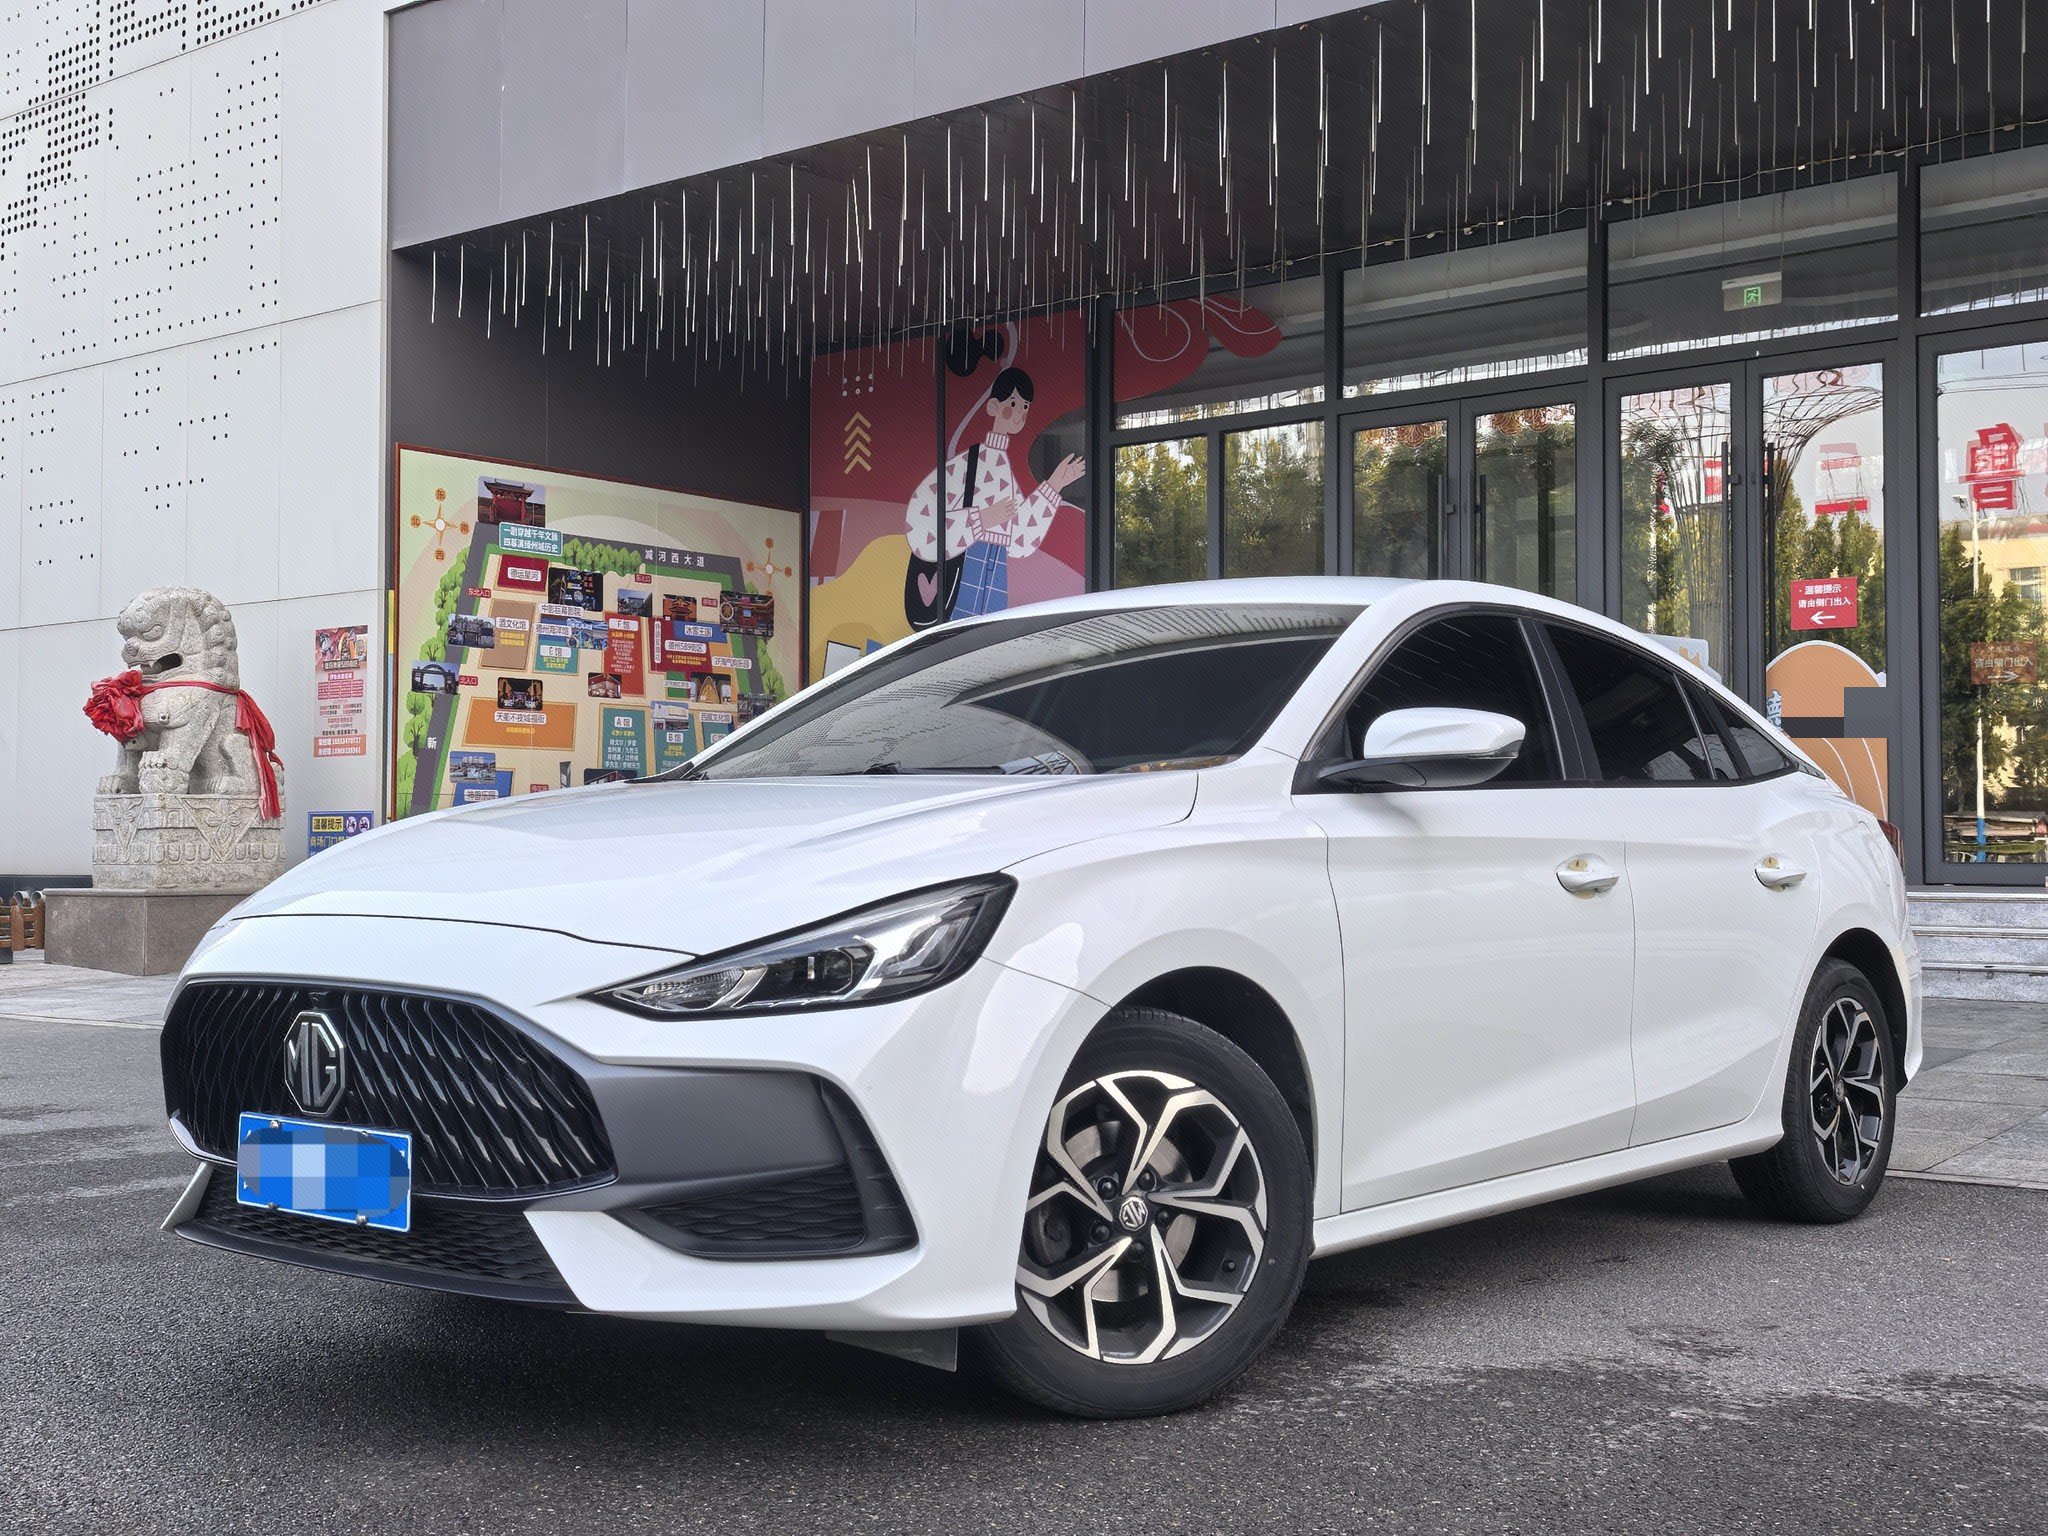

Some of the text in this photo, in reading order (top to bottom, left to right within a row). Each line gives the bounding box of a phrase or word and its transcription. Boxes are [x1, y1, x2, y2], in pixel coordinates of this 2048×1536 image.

[1805, 584, 1841, 595] 温馨提示
[1798, 596, 1851, 608] 请由侧门出入
[427, 737, 437, 750] 新
[313, 818, 342, 830] 温馨提示
[288, 1022, 337, 1108] MG
